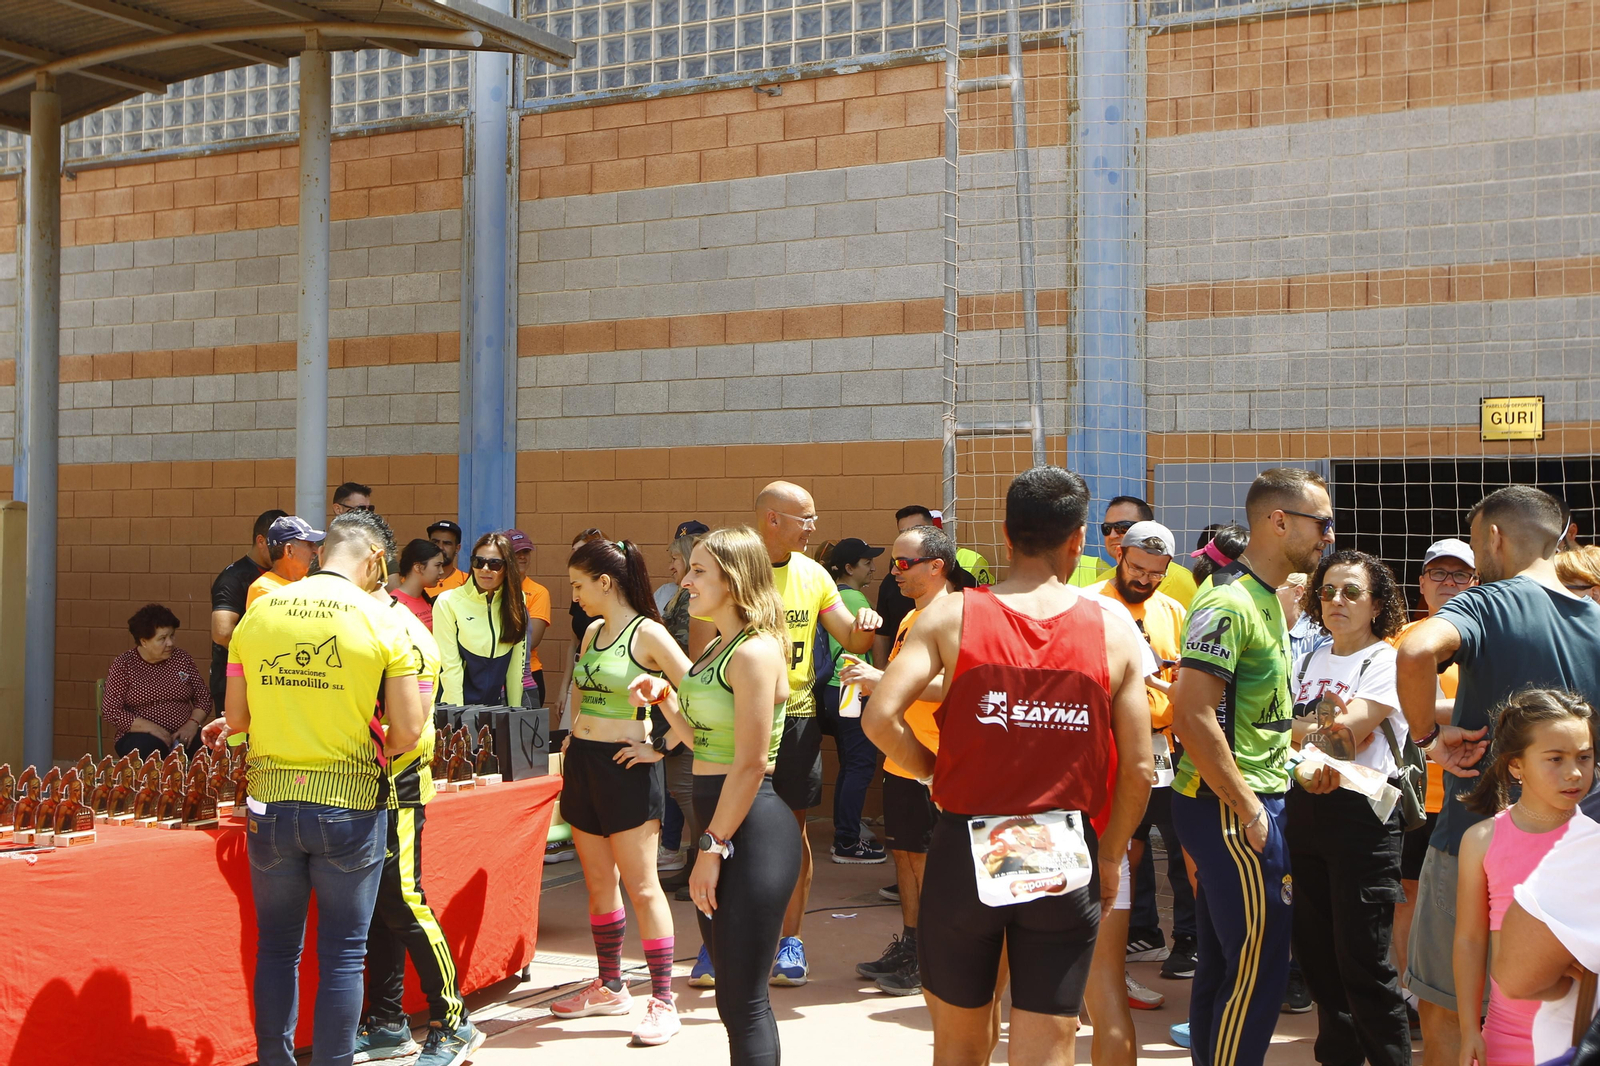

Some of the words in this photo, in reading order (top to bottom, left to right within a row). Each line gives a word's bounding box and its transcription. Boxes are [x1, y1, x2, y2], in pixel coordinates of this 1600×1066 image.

[1491, 411, 1533, 425] GURI
[269, 598, 289, 607] Bar
[292, 597, 307, 606] LA
[278, 666, 326, 678] Excavaciones
[261, 675, 273, 686] El
[275, 676, 329, 690] Manolillo
[1010, 705, 1090, 725] SAYMA
[1031, 723, 1089, 732] ATLETISMO
